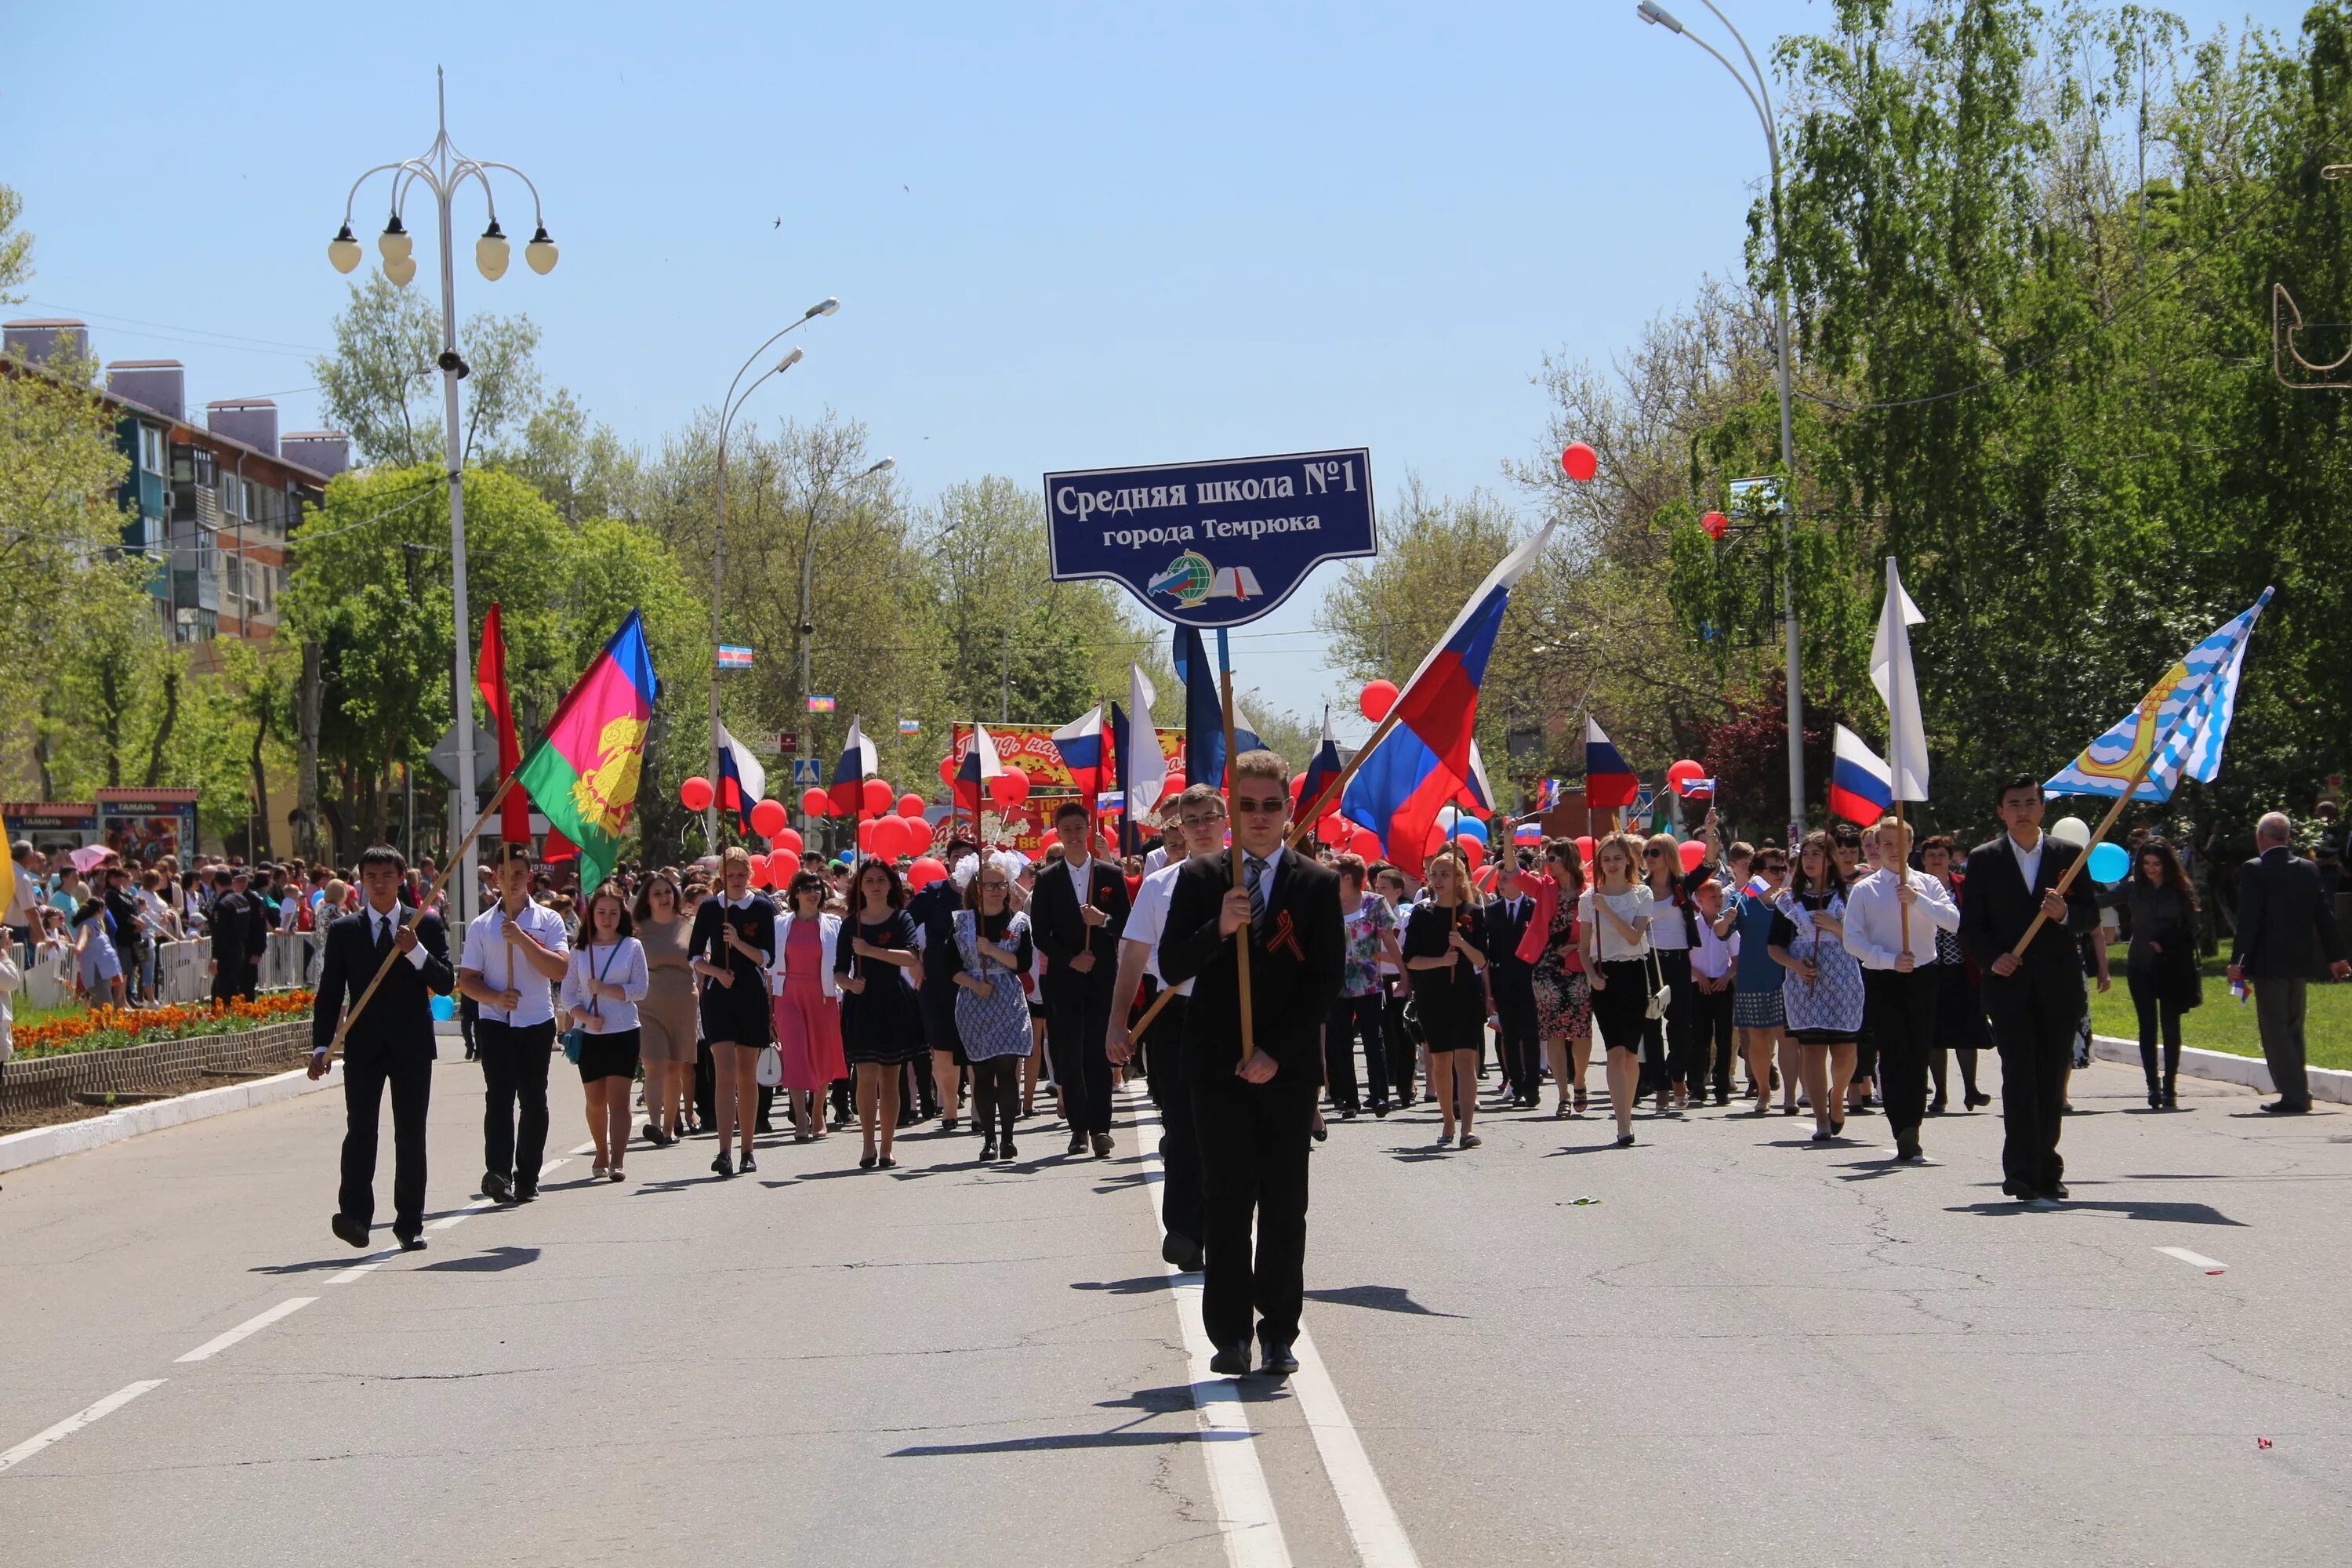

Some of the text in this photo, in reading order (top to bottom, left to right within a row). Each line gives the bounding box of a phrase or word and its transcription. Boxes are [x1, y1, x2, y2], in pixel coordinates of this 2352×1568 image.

[1056, 460, 1356, 522] Средняя школа №1
[1102, 514, 1321, 550] города Темрюка
